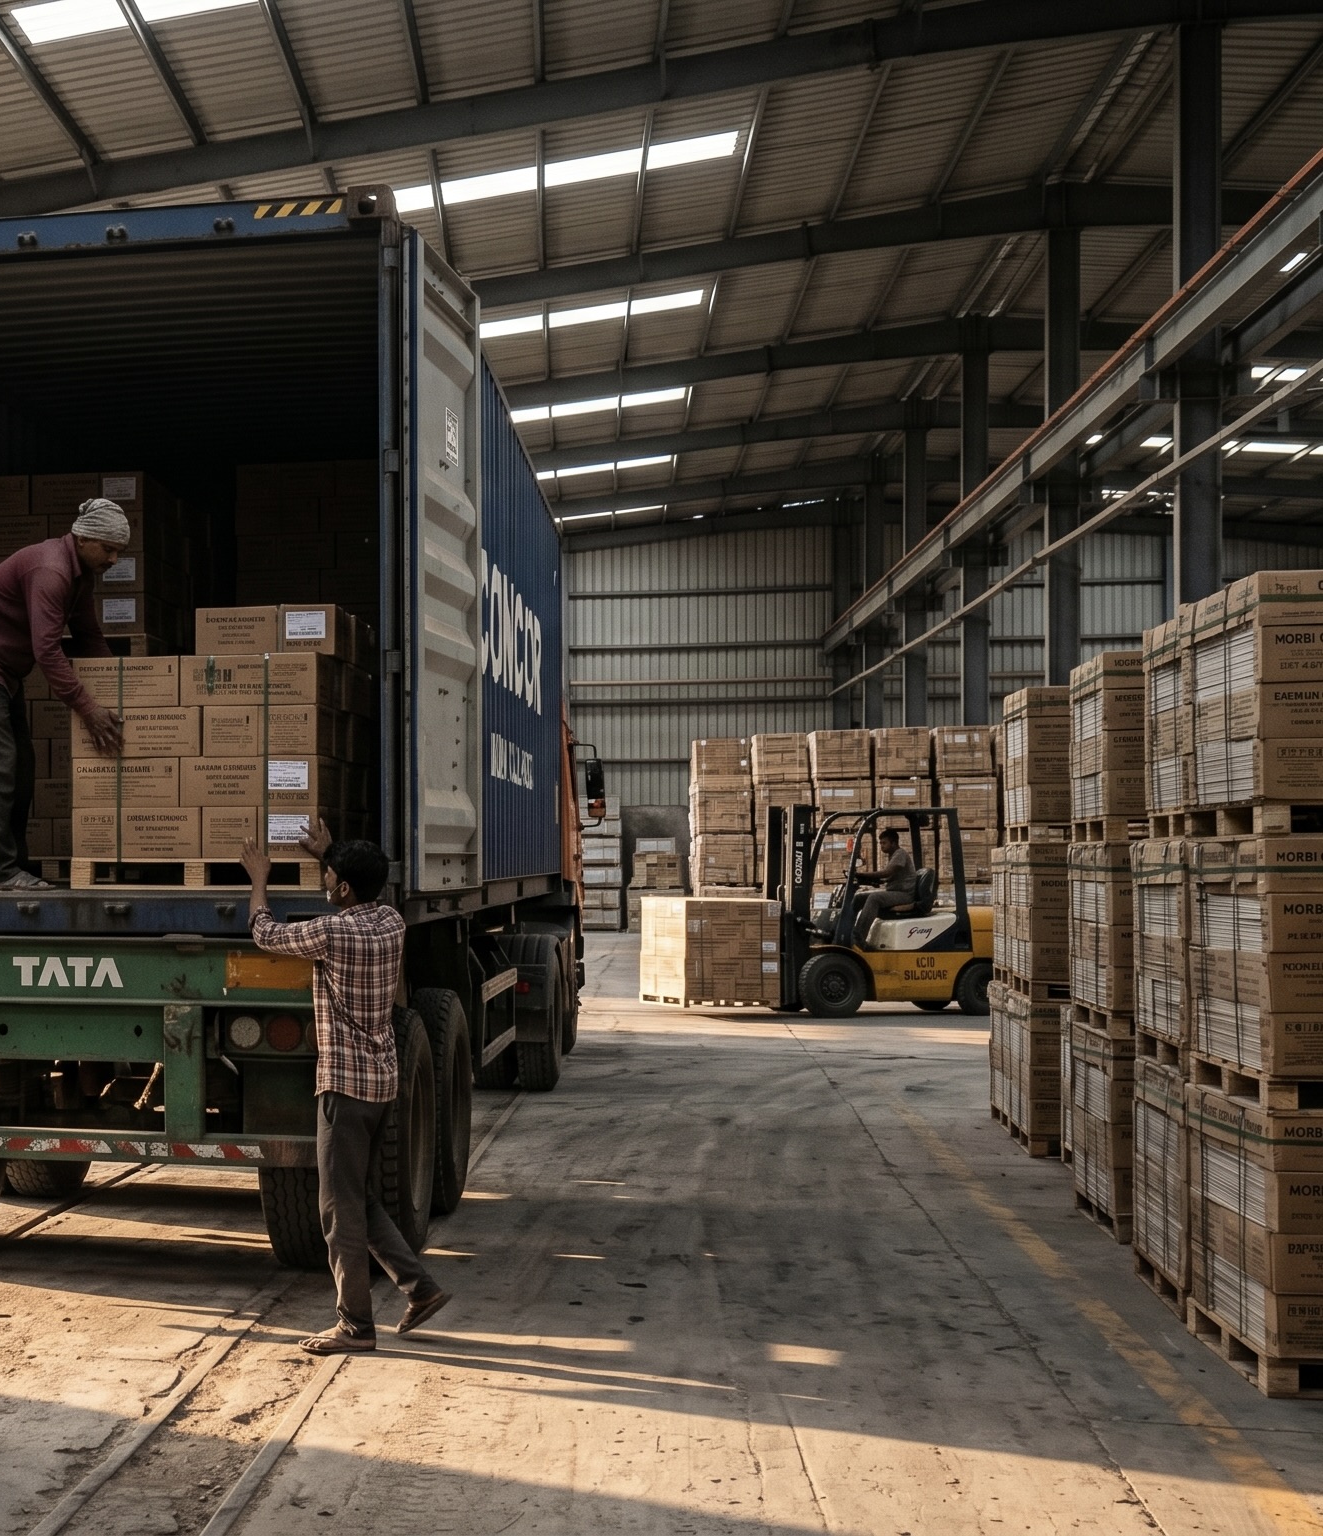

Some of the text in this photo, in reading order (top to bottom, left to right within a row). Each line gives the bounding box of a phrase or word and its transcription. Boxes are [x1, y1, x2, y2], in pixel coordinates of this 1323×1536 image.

[1275, 633, 1315, 645] MORBI
[1276, 852, 1317, 862] MORBI
[13, 956, 124, 988] TATA
[1289, 1185, 1323, 1196] MOR
